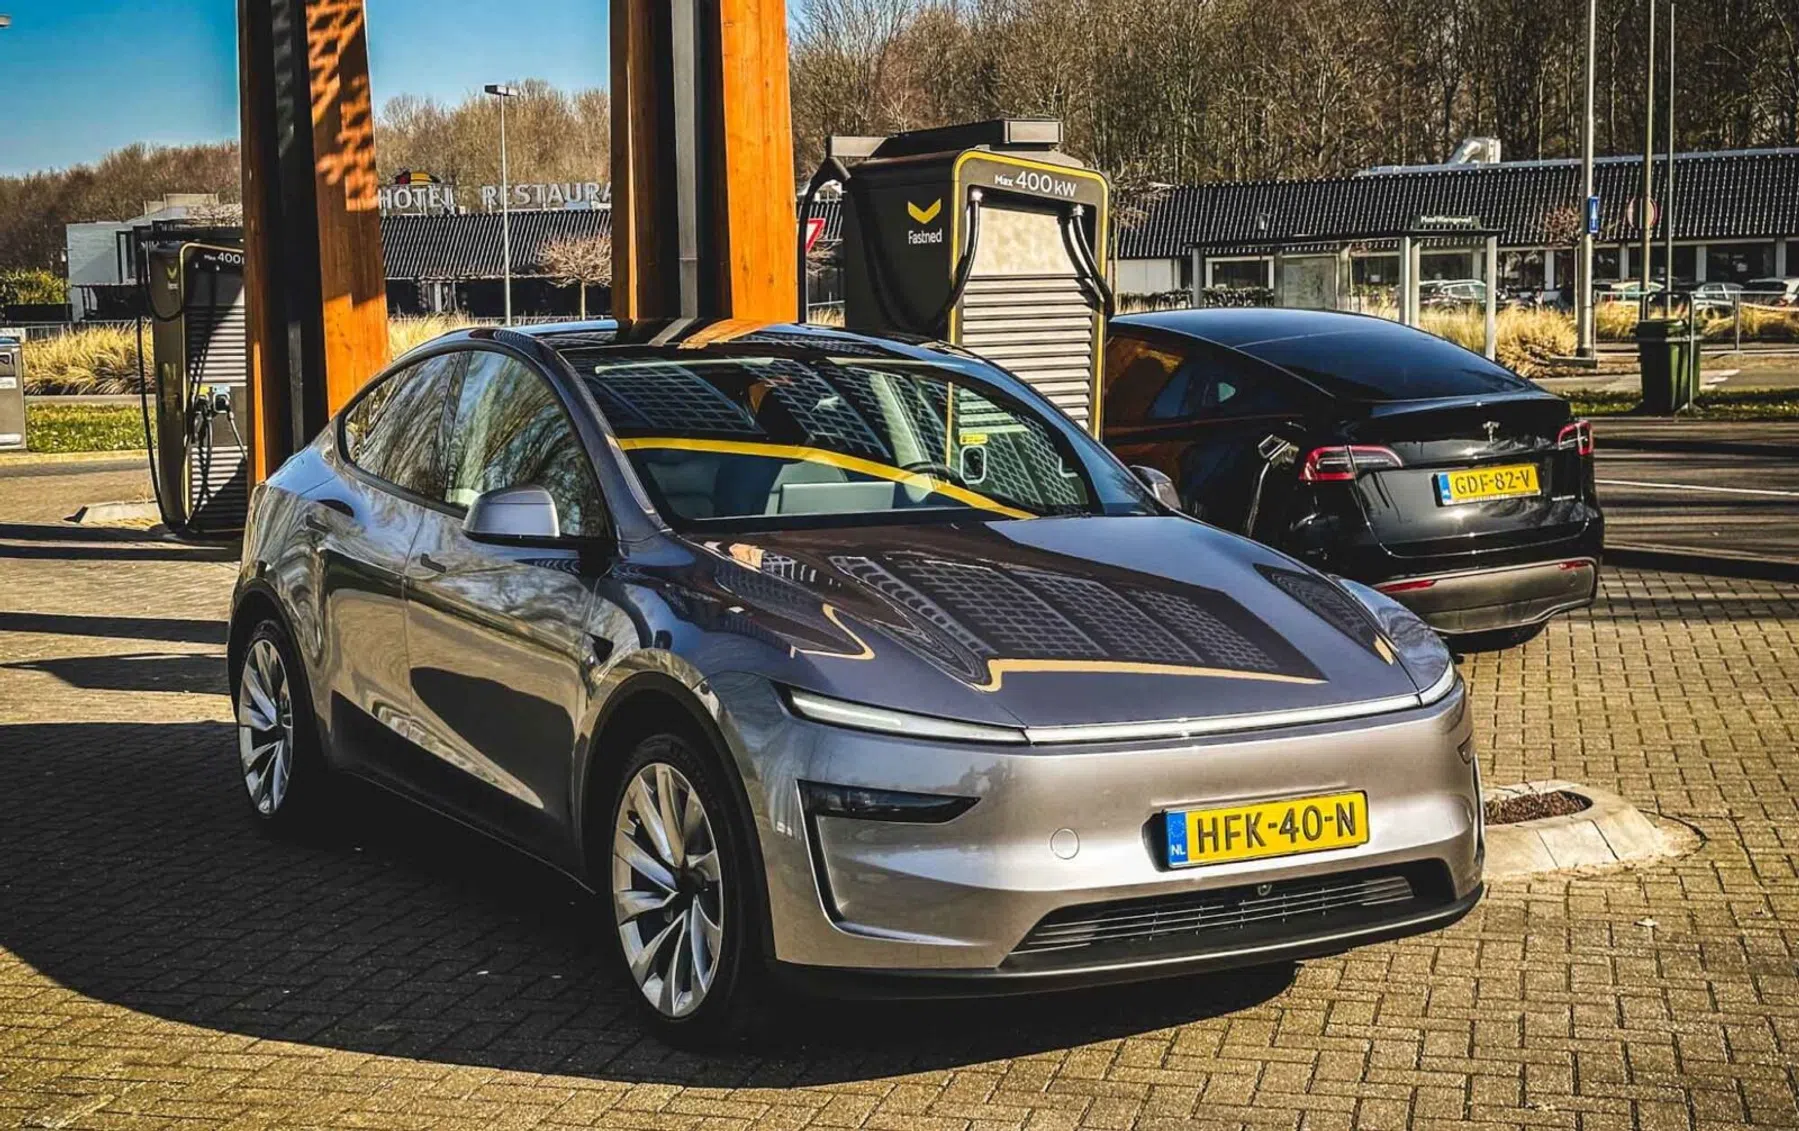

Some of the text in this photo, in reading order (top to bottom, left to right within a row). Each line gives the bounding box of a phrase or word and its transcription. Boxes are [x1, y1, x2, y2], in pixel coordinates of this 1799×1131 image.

[994, 171, 1077, 197] Max 400 kW
[377, 186, 456, 209] HOTEL
[908, 228, 943, 245] Fastned
[218, 252, 241, 264] 400
[1455, 470, 1530, 494] GDF-82-V
[1171, 802, 1356, 856] NL HFK-40-N
